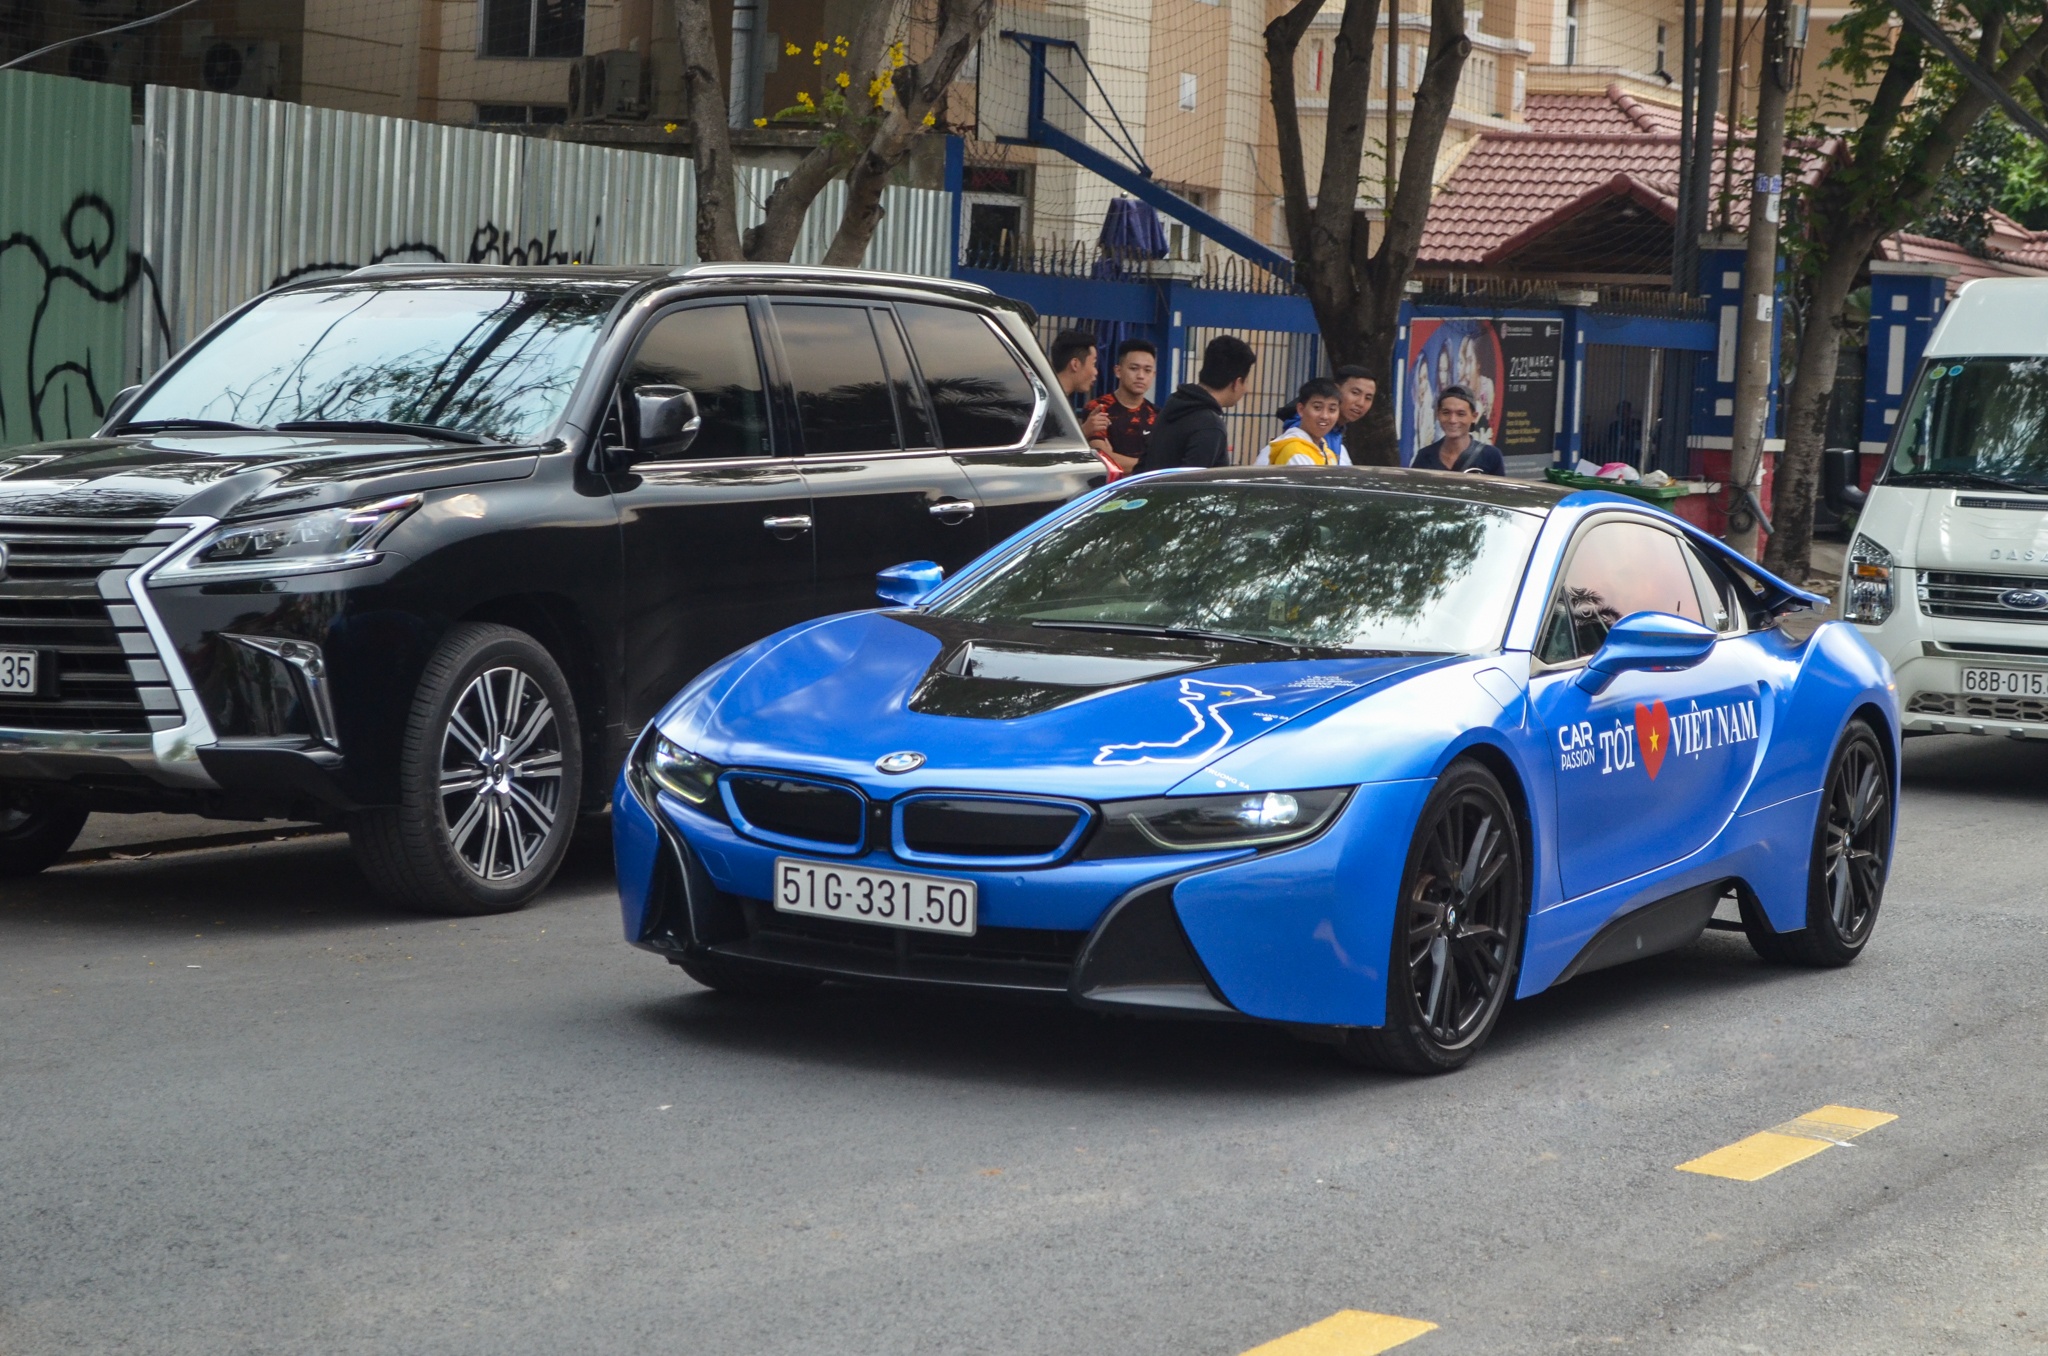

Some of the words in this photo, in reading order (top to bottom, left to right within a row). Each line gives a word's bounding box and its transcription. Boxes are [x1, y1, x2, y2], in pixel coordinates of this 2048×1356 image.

[2009, 592, 2040, 605] Ford
[1966, 670, 2048, 695] 68B-015.
[1558, 721, 1594, 751] CAR
[1600, 718, 1636, 774] TÔI
[1670, 700, 1714, 760] VIỆT
[1716, 700, 1759, 747] NAM
[1561, 748, 1596, 771] PASSION
[783, 865, 967, 928] 51G-331.50
